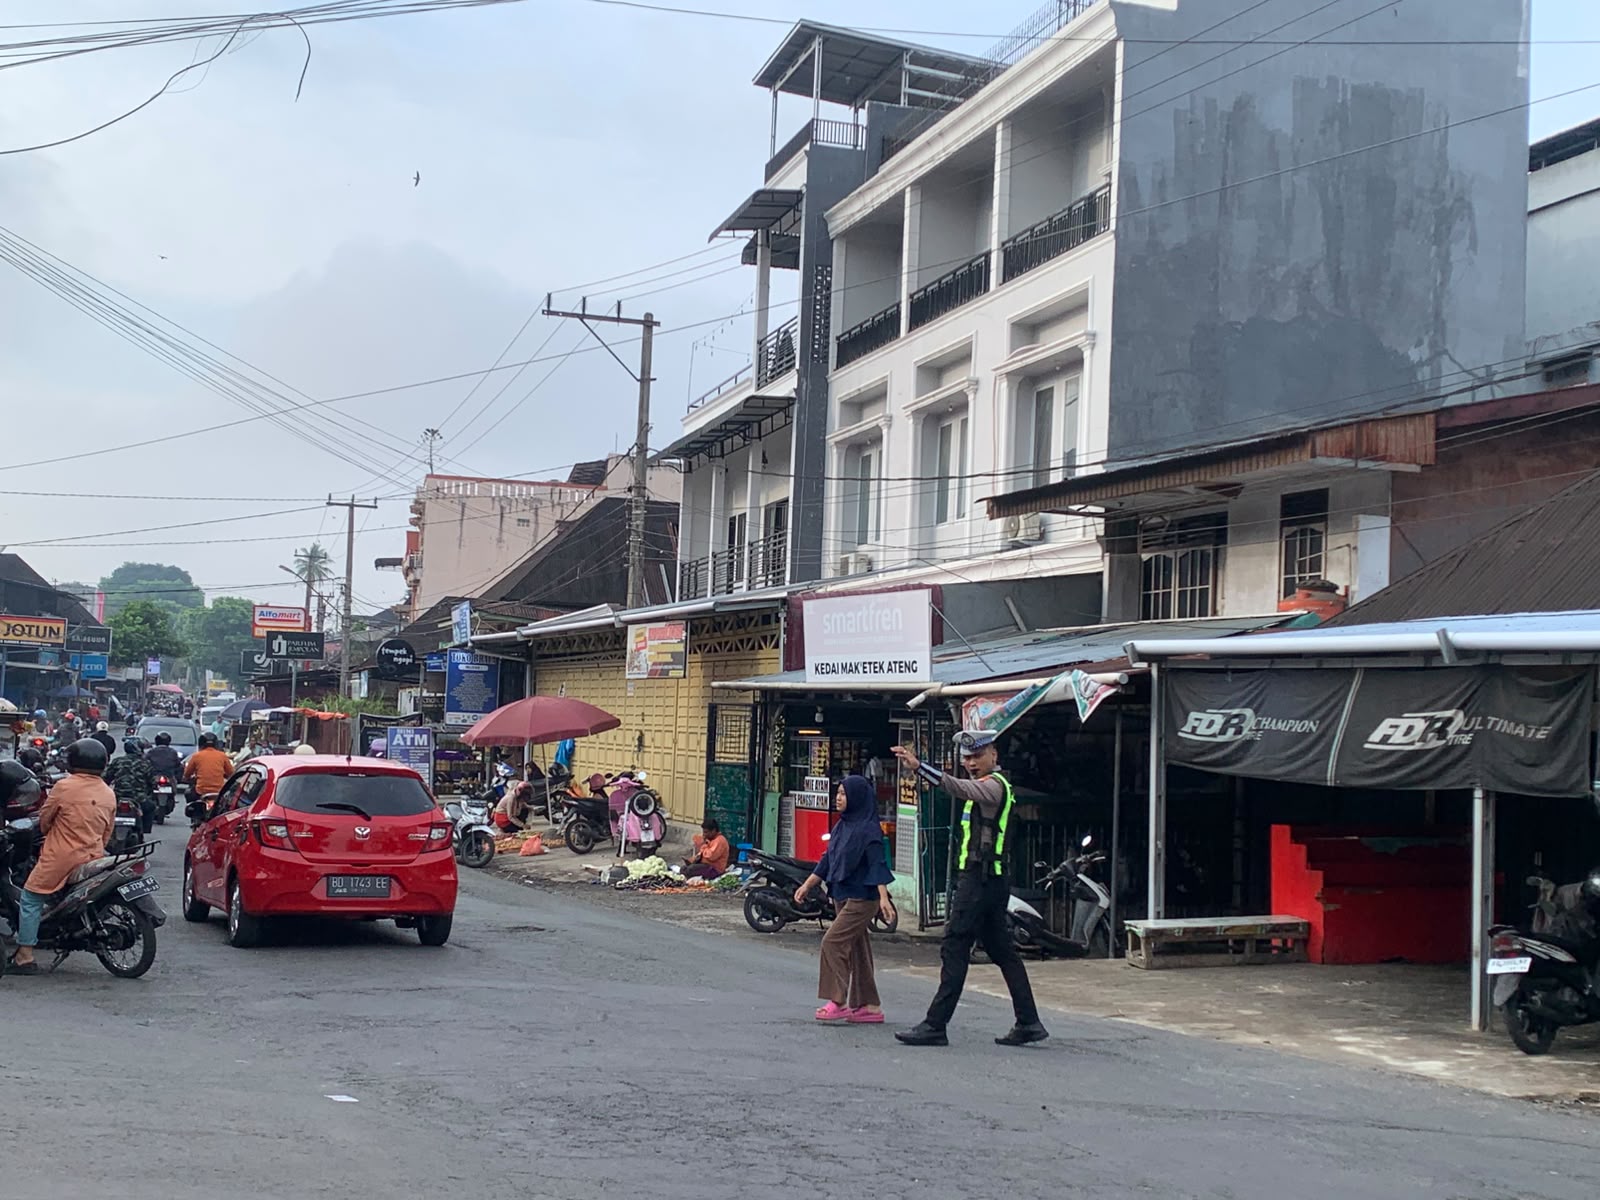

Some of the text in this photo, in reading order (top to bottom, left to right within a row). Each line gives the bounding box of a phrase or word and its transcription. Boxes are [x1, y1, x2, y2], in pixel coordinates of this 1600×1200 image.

[258, 610, 301, 619] Alfamart
[823, 601, 903, 634] smartfren
[3, 623, 60, 639] JOTUN
[71, 635, 106, 644] SASUNG
[814, 662, 840, 676] KEDAI
[887, 660, 918, 674] ATENG
[1177, 708, 1320, 743] FDR CHAMPION
[1363, 709, 1553, 751] FDR ULTIMATE
[391, 734, 429, 747] ATM
[1448, 733, 1474, 746] TIRE
[350, 877, 371, 888] 1743
